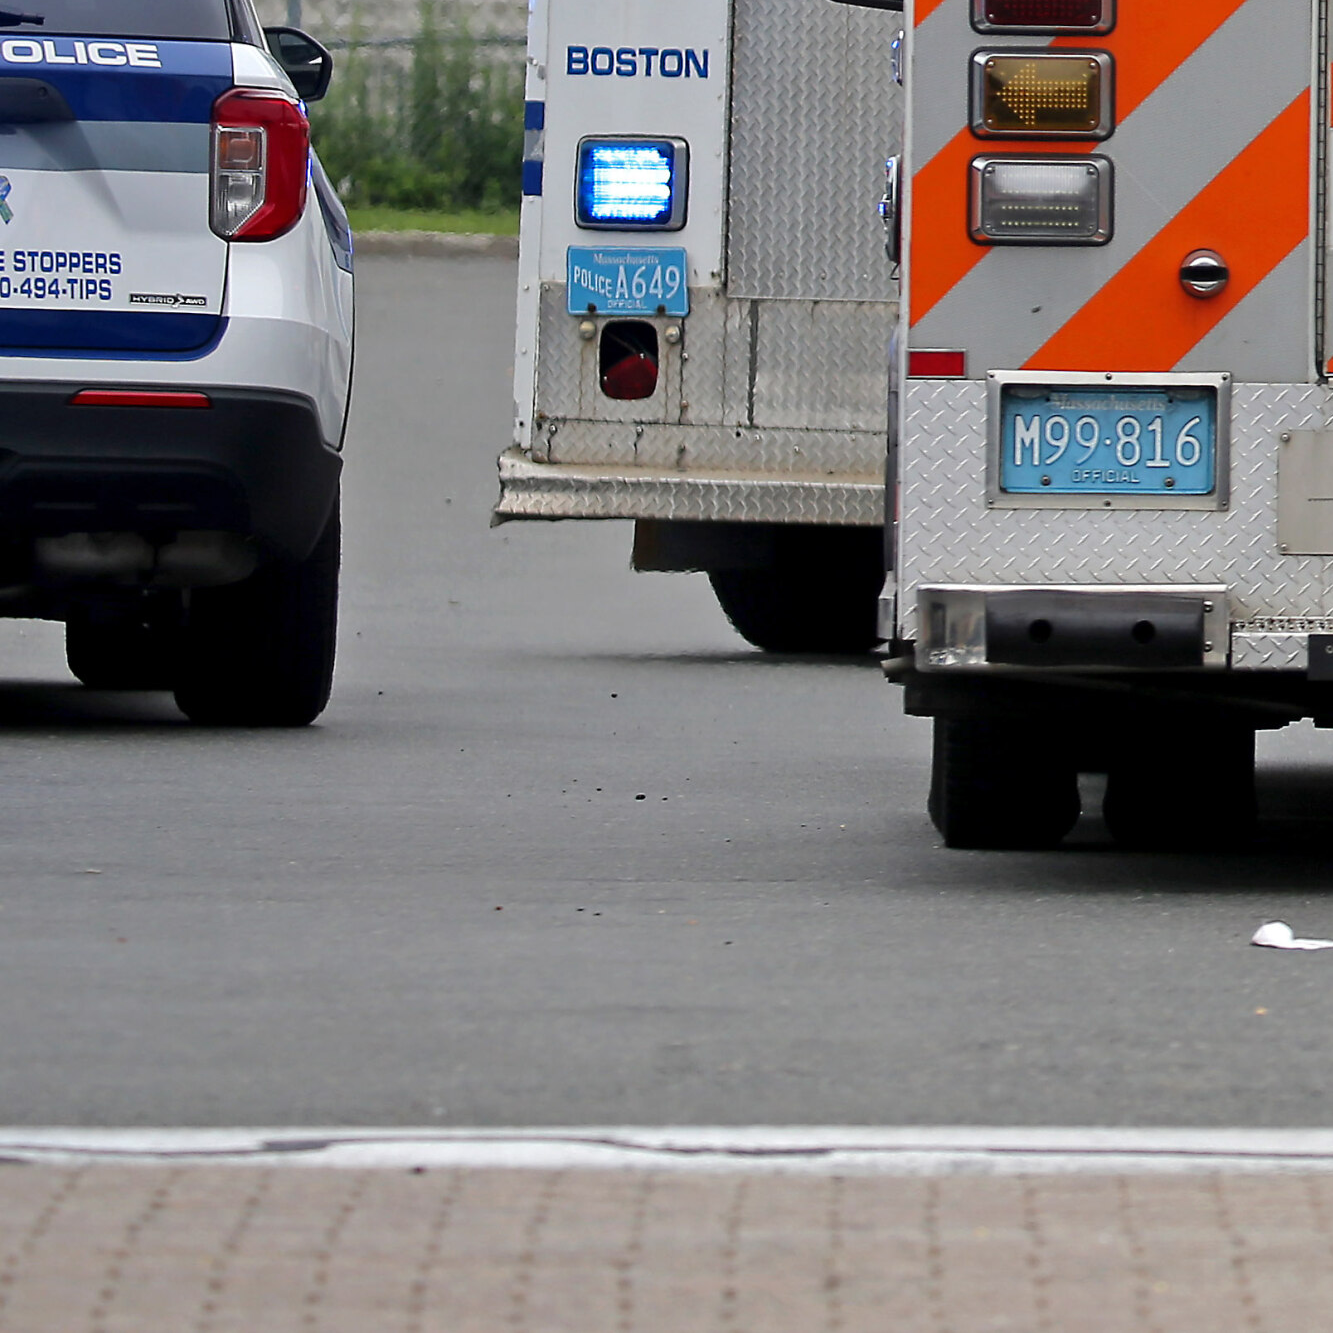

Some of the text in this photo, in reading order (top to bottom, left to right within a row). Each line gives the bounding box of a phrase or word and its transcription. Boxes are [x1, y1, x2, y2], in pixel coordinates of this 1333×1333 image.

[567, 46, 709, 78] BOSTON
[13, 251, 122, 274] STOPPERS
[574, 265, 680, 299] POLICE A649
[133, 296, 174, 304] HYBRID
[1072, 469, 1141, 483] OFFICIAL
